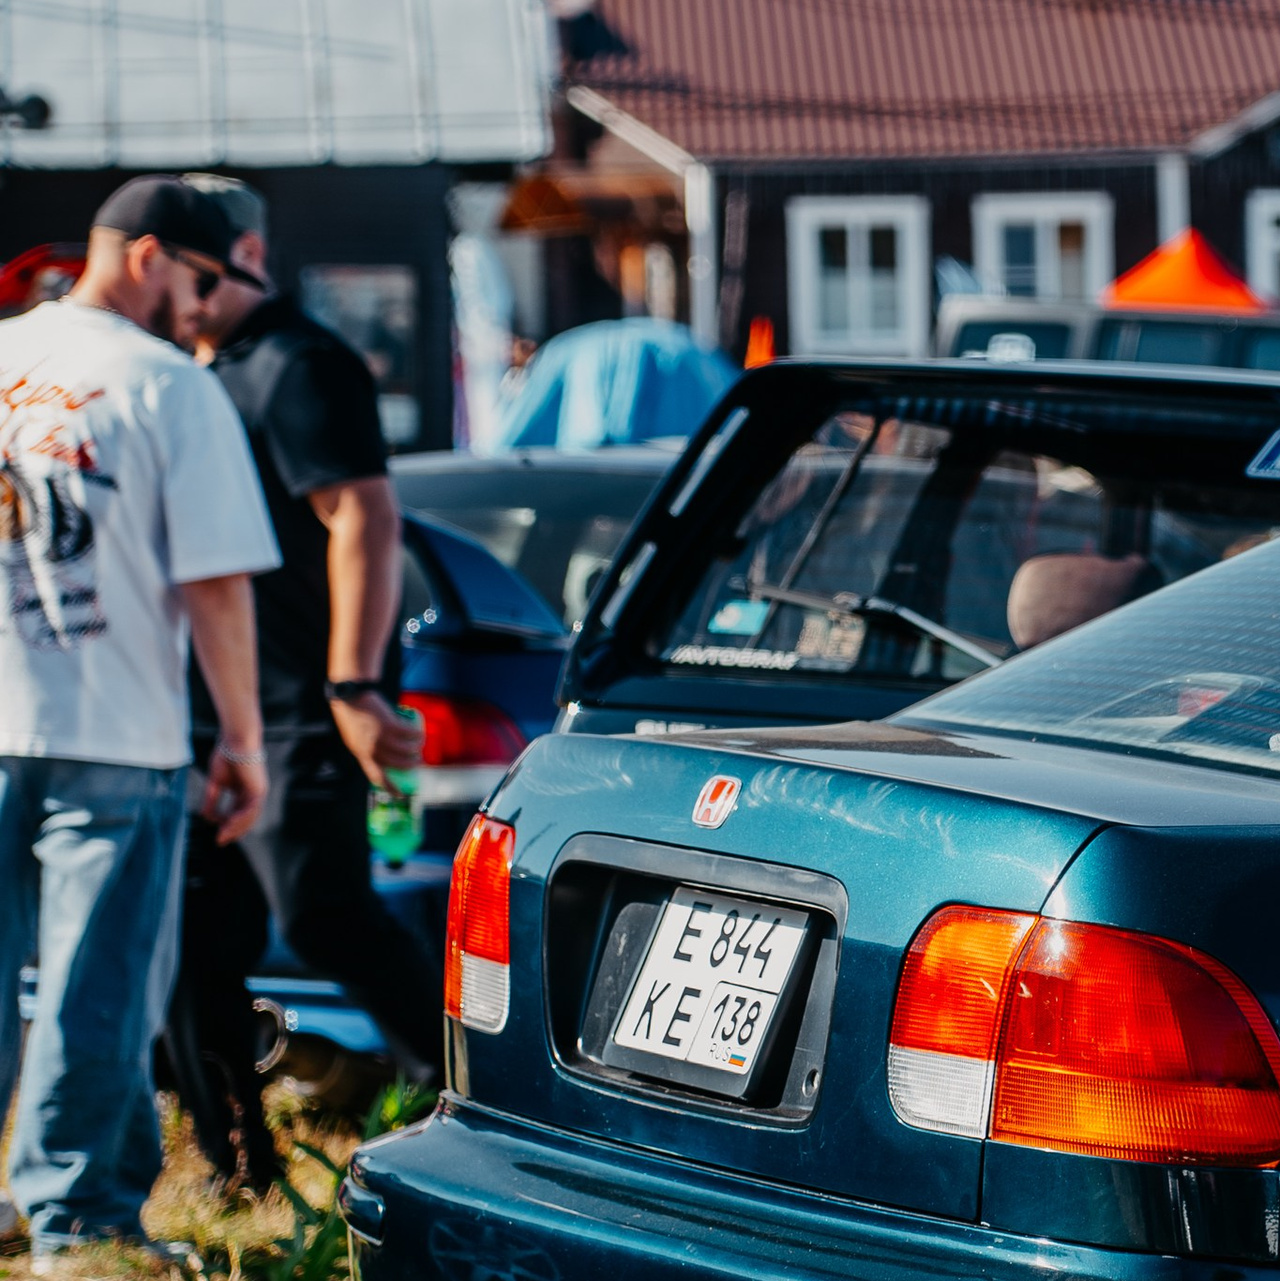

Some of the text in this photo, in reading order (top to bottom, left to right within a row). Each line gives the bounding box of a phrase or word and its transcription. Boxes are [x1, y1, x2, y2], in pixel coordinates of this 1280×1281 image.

[710, 909, 781, 978] 844
[711, 993, 761, 1045] 138
[708, 1043, 731, 1062] RUS
